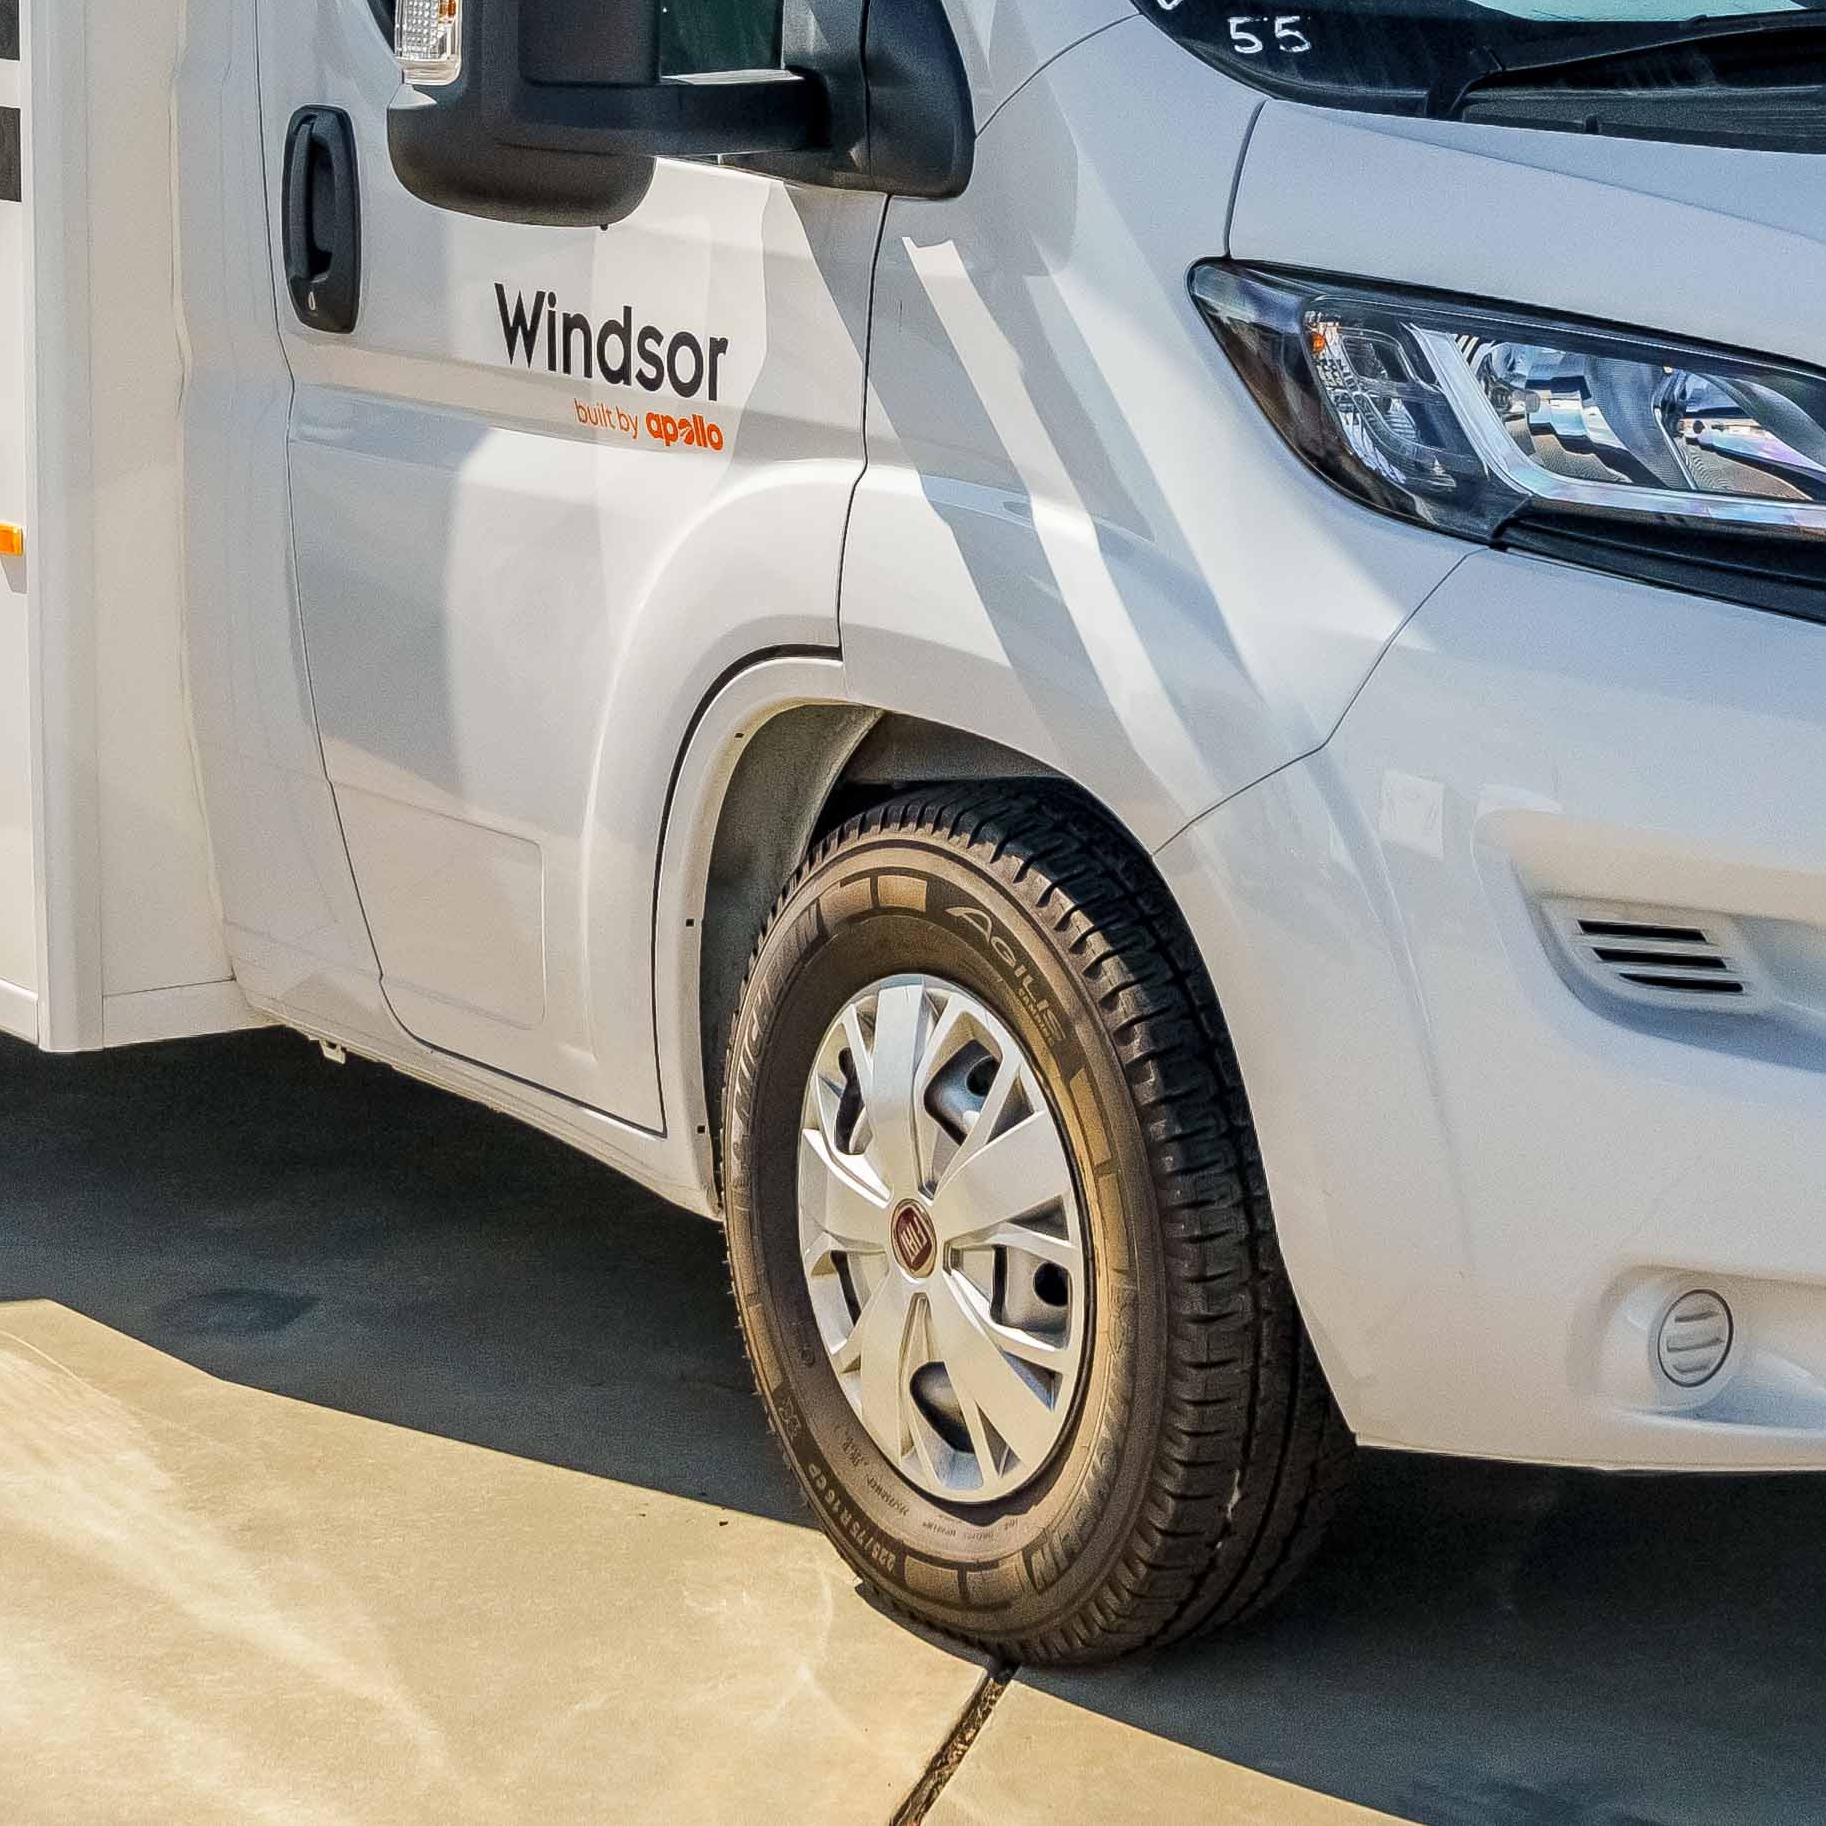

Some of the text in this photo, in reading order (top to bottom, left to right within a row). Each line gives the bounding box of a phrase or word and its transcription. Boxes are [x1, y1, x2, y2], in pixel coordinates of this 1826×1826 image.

[494, 282, 729, 401] Windsor
[574, 398, 724, 450] built by apollo
